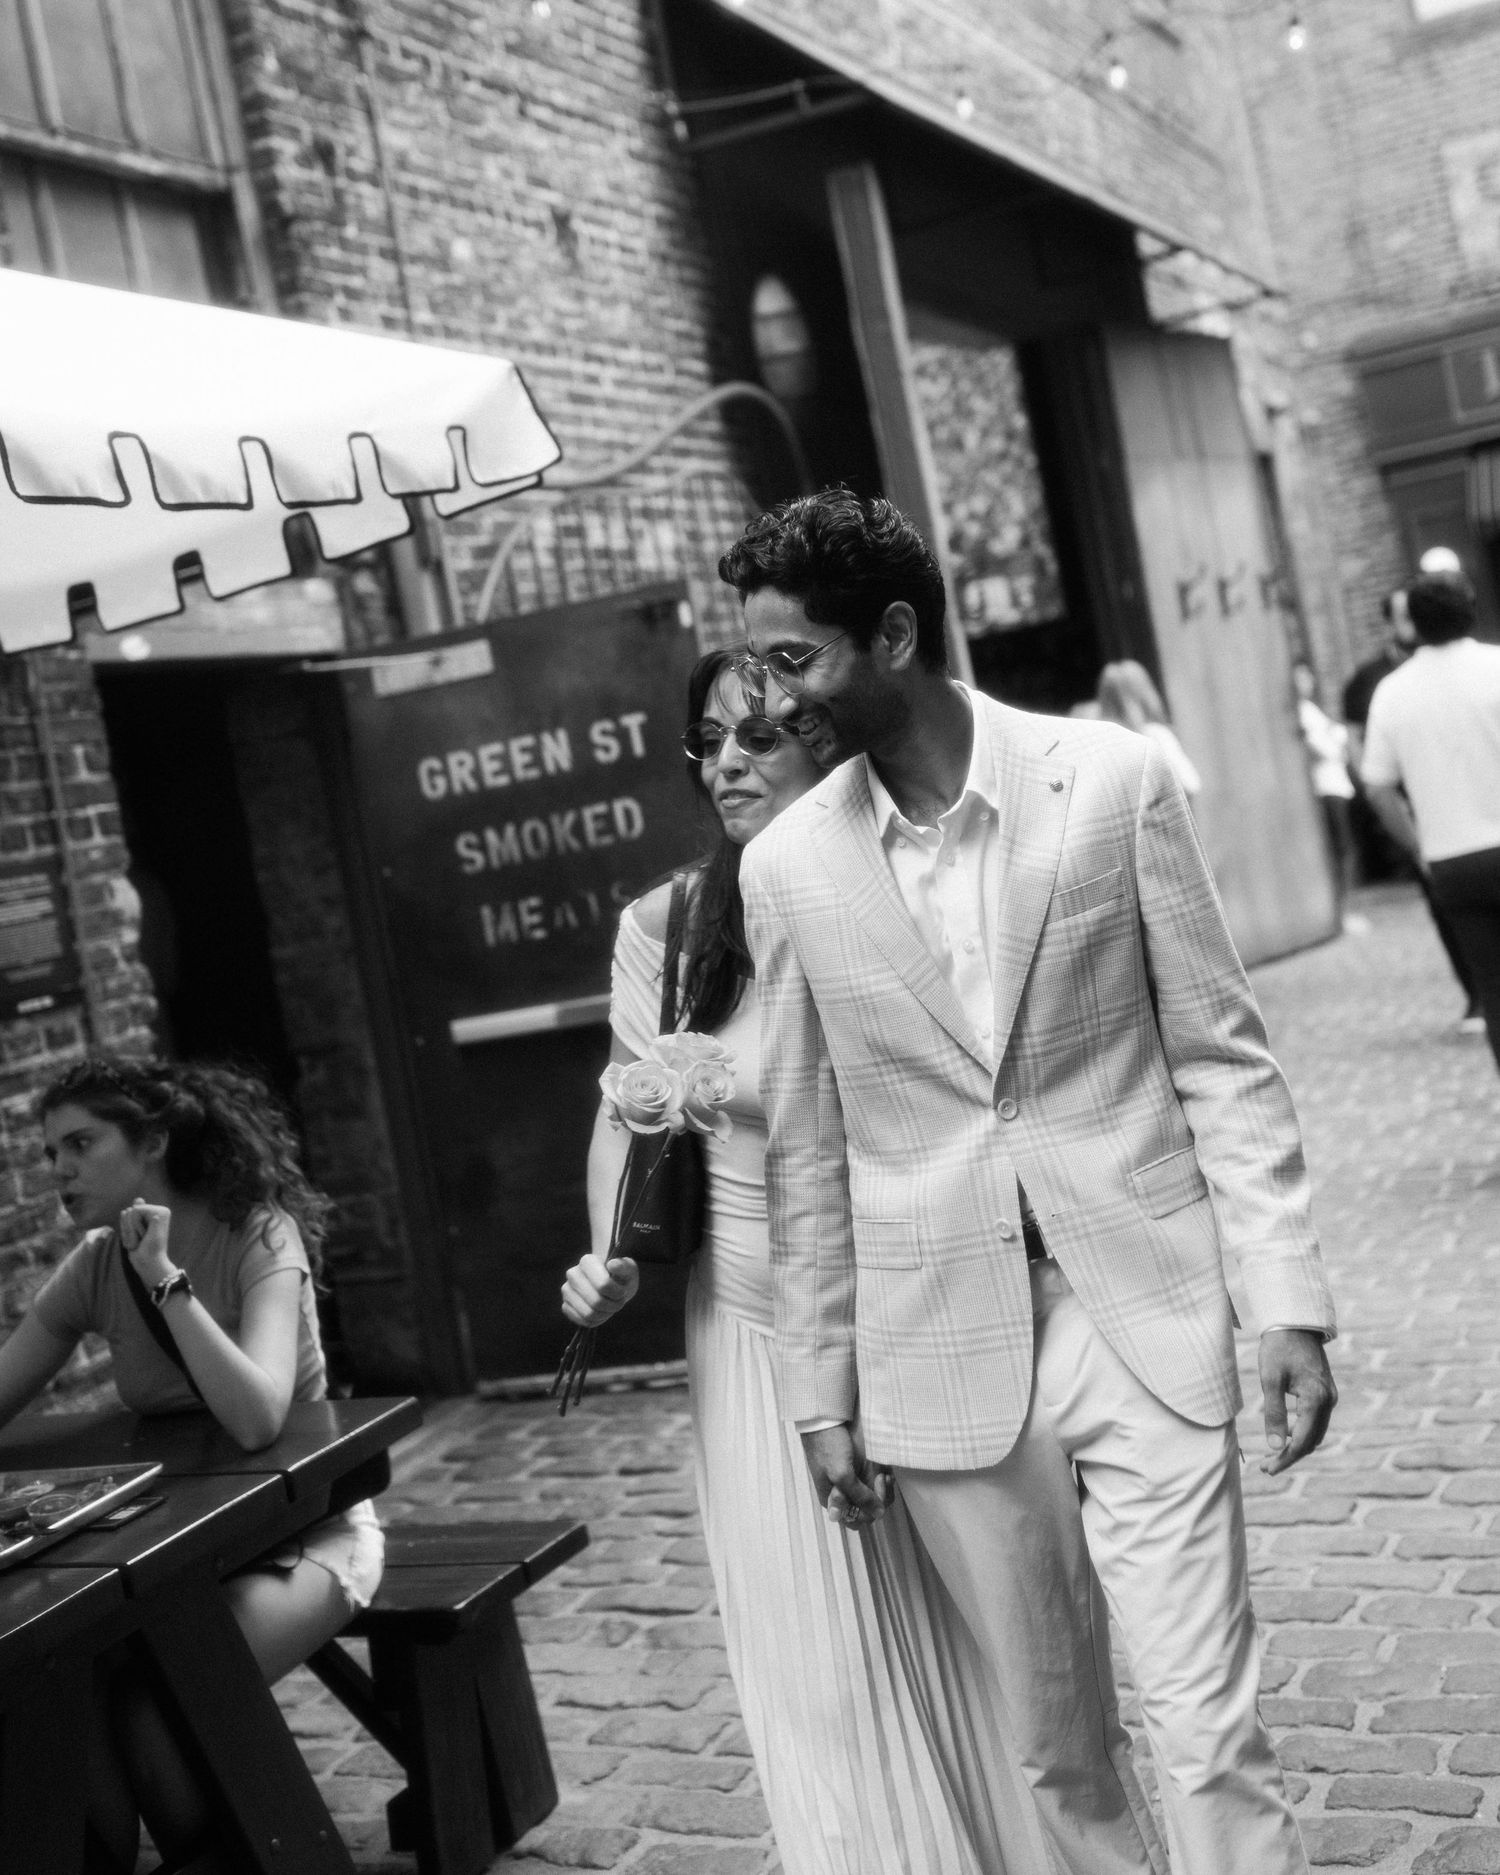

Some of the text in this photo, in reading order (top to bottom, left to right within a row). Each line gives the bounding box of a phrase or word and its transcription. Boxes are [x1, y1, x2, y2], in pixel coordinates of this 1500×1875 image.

[417, 711, 648, 800] GREEN ST
[455, 796, 645, 875] SMOKED
